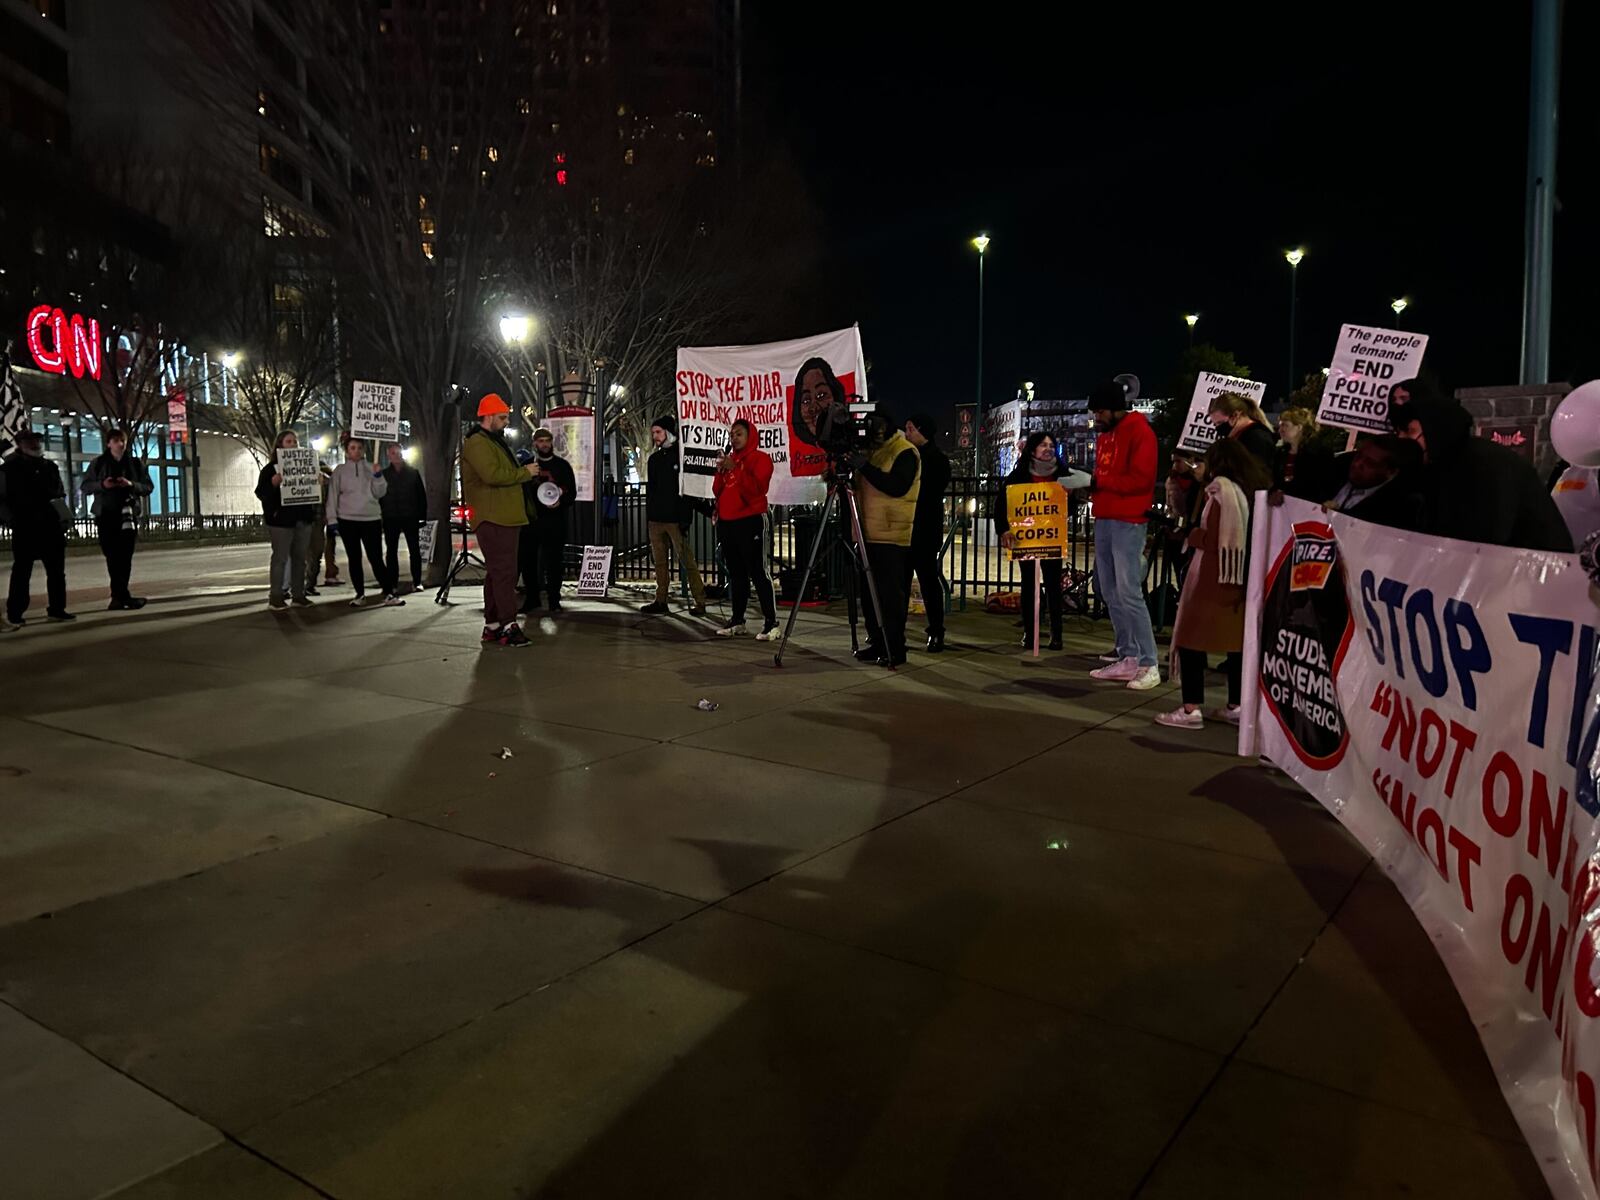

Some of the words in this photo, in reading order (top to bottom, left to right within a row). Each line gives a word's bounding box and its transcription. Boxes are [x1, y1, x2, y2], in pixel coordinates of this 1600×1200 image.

[27, 303, 102, 382] CNN
[1347, 327, 1372, 341] The
[1372, 333, 1421, 349] people
[1350, 343, 1408, 361] demand:
[1352, 359, 1394, 380] END
[676, 370, 713, 399] STOP
[715, 375, 745, 402] THE
[748, 370, 783, 402] WAR
[1204, 372, 1224, 384] The
[1224, 378, 1261, 391] people
[358, 384, 396, 396] JUSTICE
[1334, 378, 1389, 400] POLIC
[371, 394, 394, 404] TYRE
[1328, 393, 1387, 417] TERRO
[357, 400, 396, 413] NICHOLS
[680, 400, 697, 420] ON
[700, 401, 732, 425] BLACK
[735, 402, 785, 425] AMERICA
[356, 411, 372, 421] Jail
[373, 413, 396, 424] Killer
[364, 421, 388, 432] Cops!
[704, 426, 727, 448] RIG
[758, 427, 786, 449] EBEL
[281, 449, 314, 459] JUSTICE
[294, 458, 314, 467] TYRE
[282, 466, 316, 477] NICHOLS
[283, 479, 297, 487] Jail
[290, 486, 313, 496] Cops!
[1022, 491, 1050, 506] JAIL
[1014, 504, 1059, 518] KILLER
[1015, 527, 1059, 541] COPS!
[587, 561, 603, 571] END
[582, 571, 606, 580] POLICE
[579, 580, 605, 589] TERROR
[1360, 569, 1493, 712] STOP
[1270, 683, 1290, 704] OF
